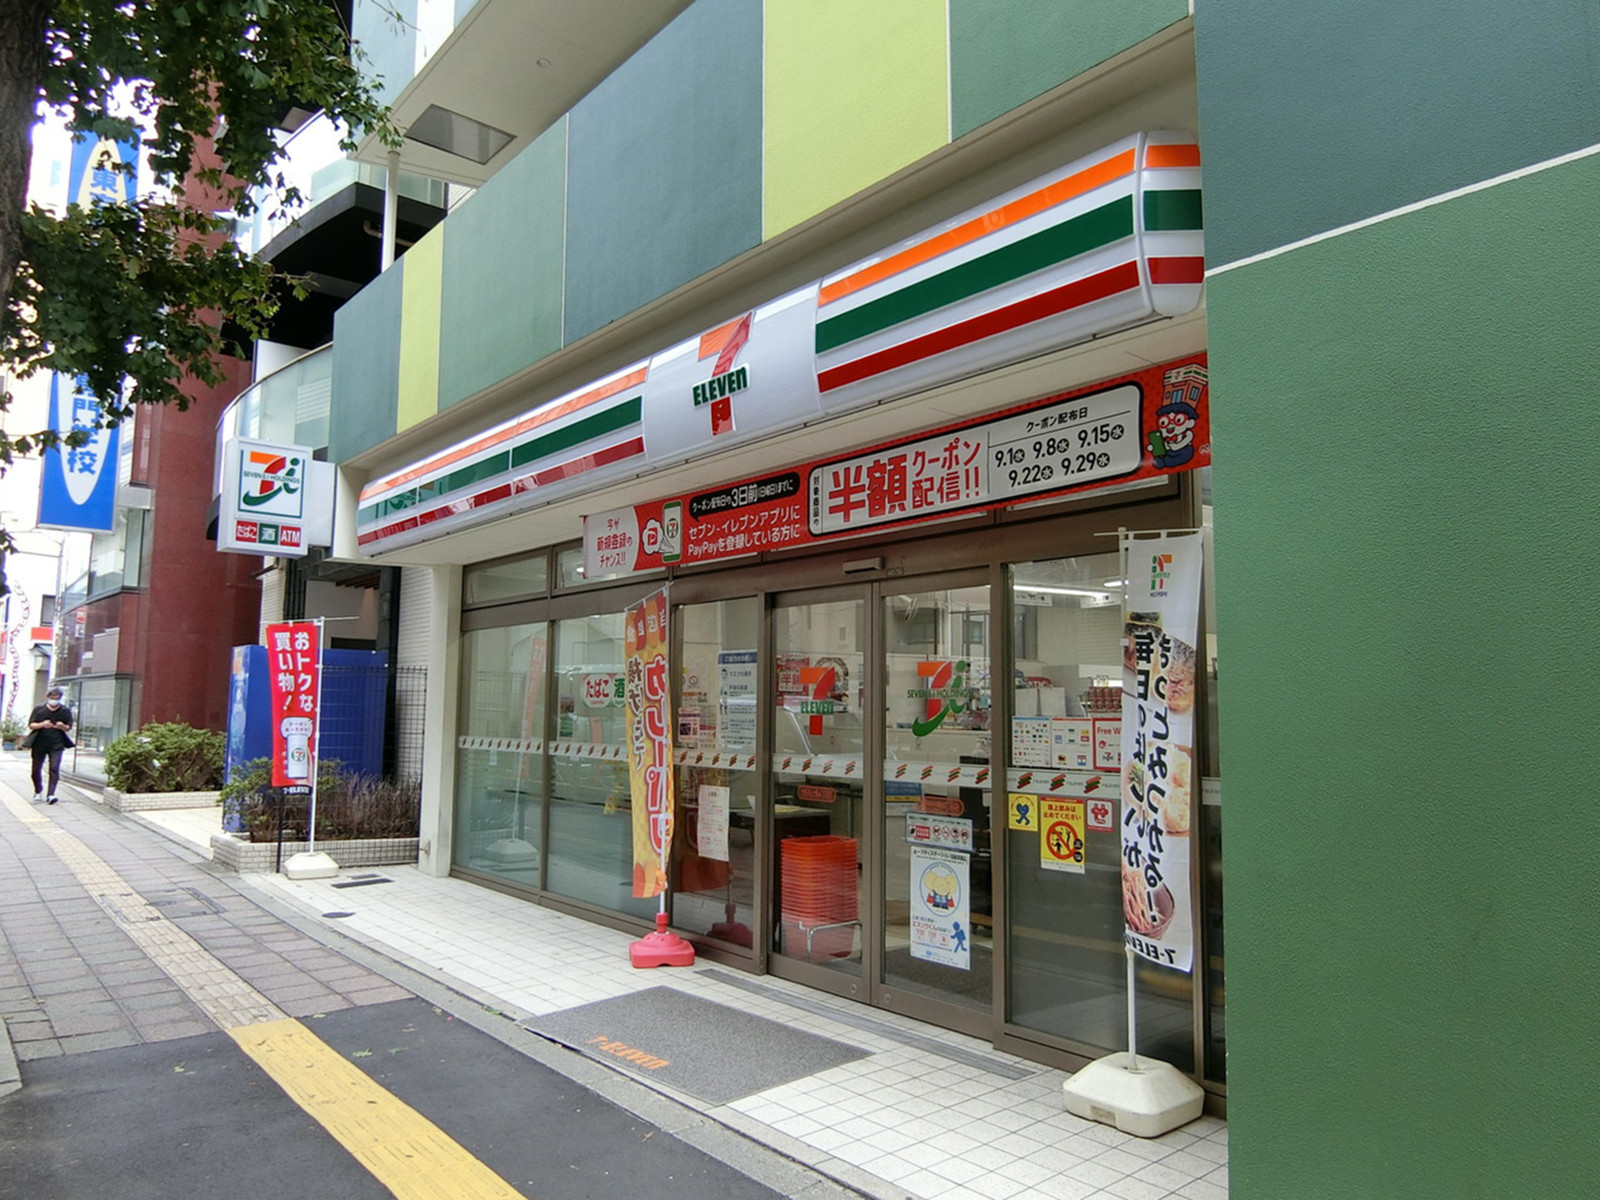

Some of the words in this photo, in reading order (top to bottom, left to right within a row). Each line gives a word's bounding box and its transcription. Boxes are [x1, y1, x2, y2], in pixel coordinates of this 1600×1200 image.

[1026, 407, 1088, 433] クーポン配布日
[912, 438, 981, 478] クーポン
[828, 454, 907, 523] 半額
[281, 529, 301, 544] ATM
[274, 632, 296, 711] 買い物!
[294, 632, 314, 712] おトクな
[585, 679, 610, 699] たばこ
[614, 678, 625, 698] 酒
[1097, 727, 1113, 735] Free
[1043, 811, 1081, 821] 止めてください
